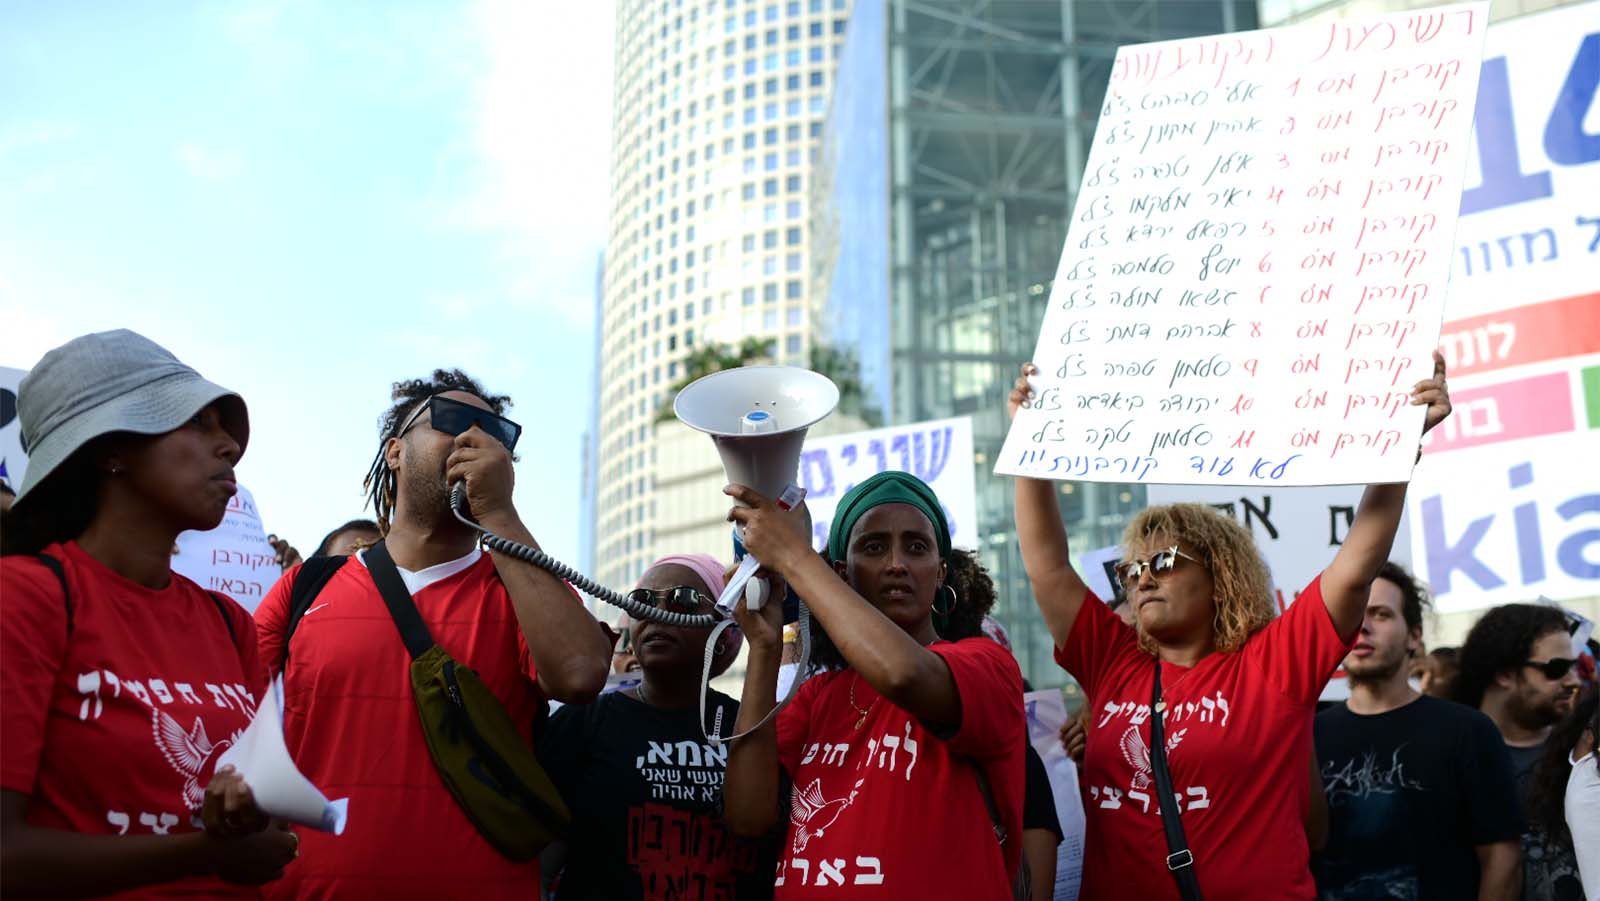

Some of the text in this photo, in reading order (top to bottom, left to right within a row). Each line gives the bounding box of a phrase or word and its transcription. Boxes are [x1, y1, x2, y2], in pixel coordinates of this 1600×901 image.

[1287, 76, 1301, 97] 1
[1372, 59, 1460, 104] קורבן
[1374, 99, 1458, 134] קורבן
[1277, 152, 1290, 169] 3
[1374, 139, 1449, 168] קורבן
[1266, 185, 1284, 205] 4
[1361, 174, 1442, 209] קורבן
[1354, 212, 1436, 249] קורבן
[1258, 250, 1272, 273] 6
[1355, 248, 1427, 278] קורבן
[1353, 283, 1428, 315] קורבן
[1165, 317, 1237, 341] אברהם
[1249, 320, 1261, 338] 8
[1345, 319, 1416, 350] קורבן
[1169, 352, 1232, 389] סלמון
[1243, 358, 1259, 377] 9
[1344, 355, 1412, 386] קורבן
[1160, 393, 1220, 413] יהודה
[1230, 393, 1255, 415] 10
[1343, 391, 1410, 420] קורבן
[1149, 422, 1213, 456] סלמון
[1230, 429, 1256, 448] 11
[1329, 428, 1402, 459] קורבן
[1189, 455, 1234, 476] עוד
[1249, 453, 1304, 479] לא
[212, 549, 276, 571] הקורבן
[641, 768, 682, 783] שאני
[652, 783, 695, 801] אהיה
